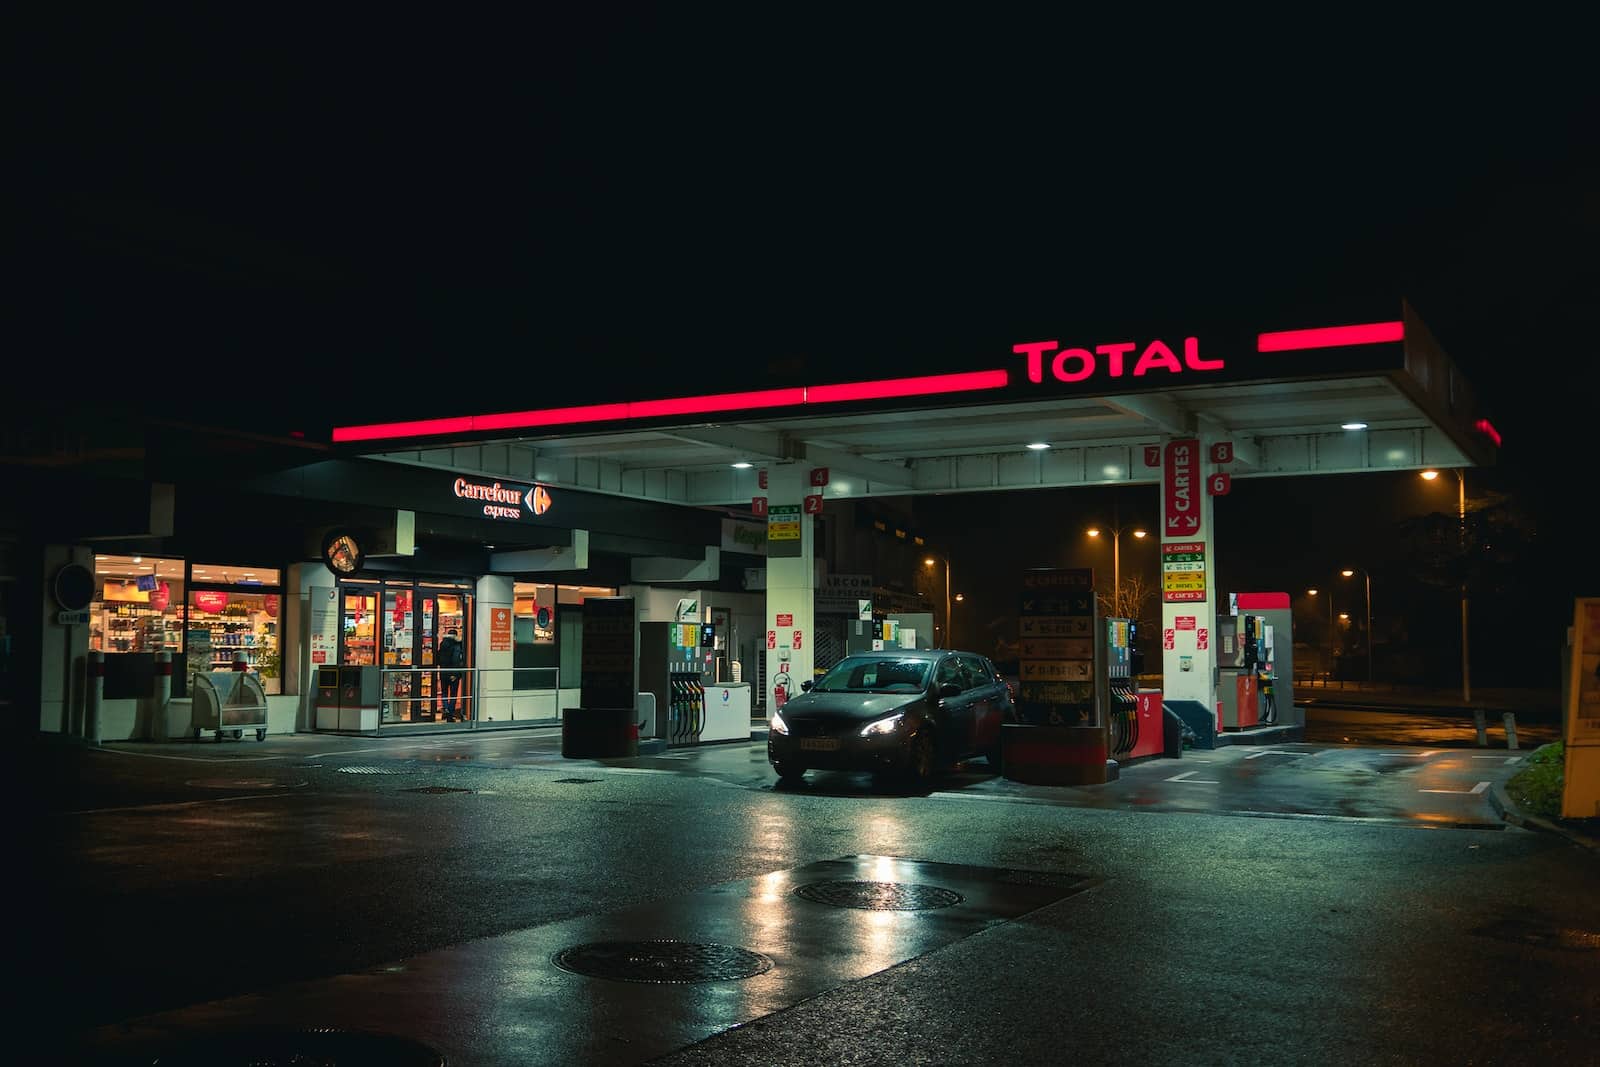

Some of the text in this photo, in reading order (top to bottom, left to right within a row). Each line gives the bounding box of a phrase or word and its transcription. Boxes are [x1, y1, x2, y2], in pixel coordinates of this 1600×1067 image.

[1012, 336, 1225, 384] TOTAL
[1149, 449, 1160, 464] 7
[1217, 446, 1228, 460] 8
[815, 471, 824, 483] 4
[1174, 445, 1190, 512] CARTES
[1213, 477, 1225, 492] 6
[454, 477, 522, 505] Carrefour
[483, 504, 521, 520] express
[756, 500, 763, 513] 1
[809, 498, 818, 511] 2
